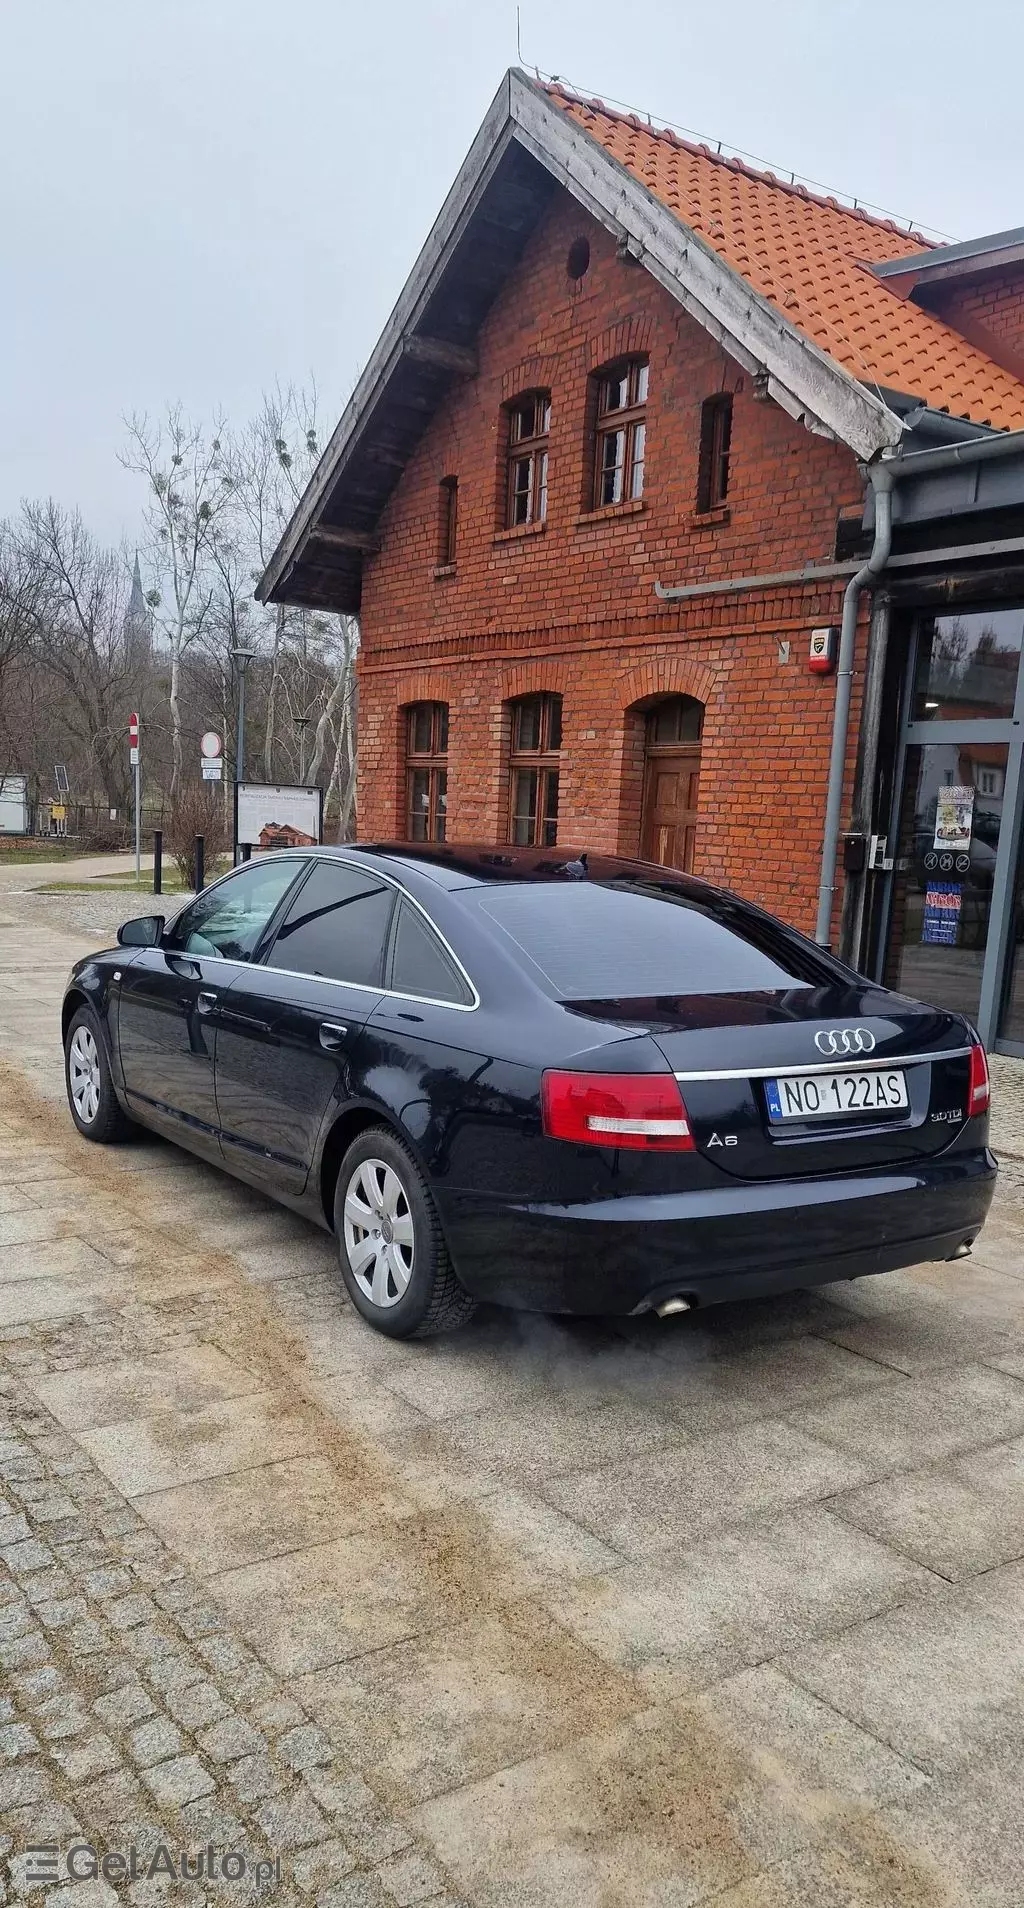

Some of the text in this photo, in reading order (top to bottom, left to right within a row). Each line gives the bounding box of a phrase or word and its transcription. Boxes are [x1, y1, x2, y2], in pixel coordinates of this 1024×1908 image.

[784, 1075, 901, 1113] NO 122AS
[770, 1103, 781, 1113] PL
[706, 1132, 738, 1148] A6
